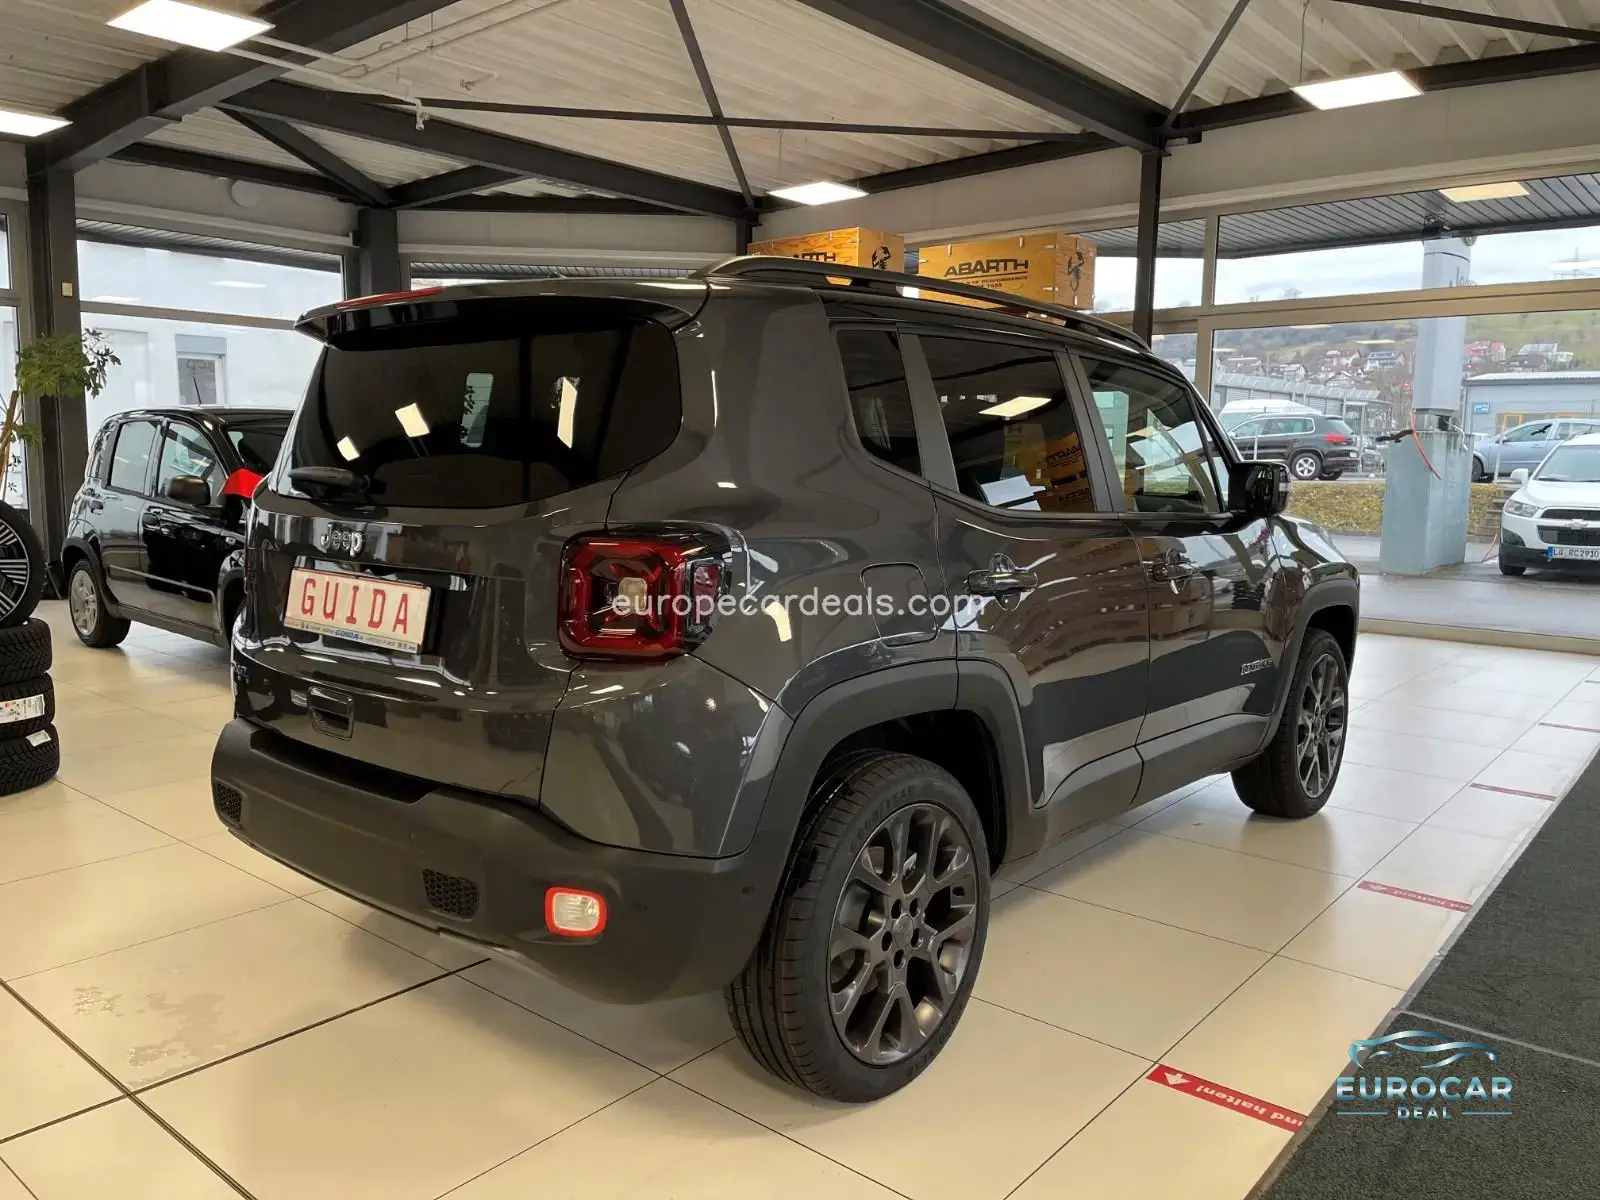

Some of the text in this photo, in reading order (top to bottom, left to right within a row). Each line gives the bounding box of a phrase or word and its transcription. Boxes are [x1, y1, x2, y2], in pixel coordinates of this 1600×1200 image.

[944, 258, 1029, 278] ABARTH
[320, 524, 363, 557] Jeep
[301, 578, 411, 634] GUIDA
[1196, 1085, 1267, 1115] halten!
